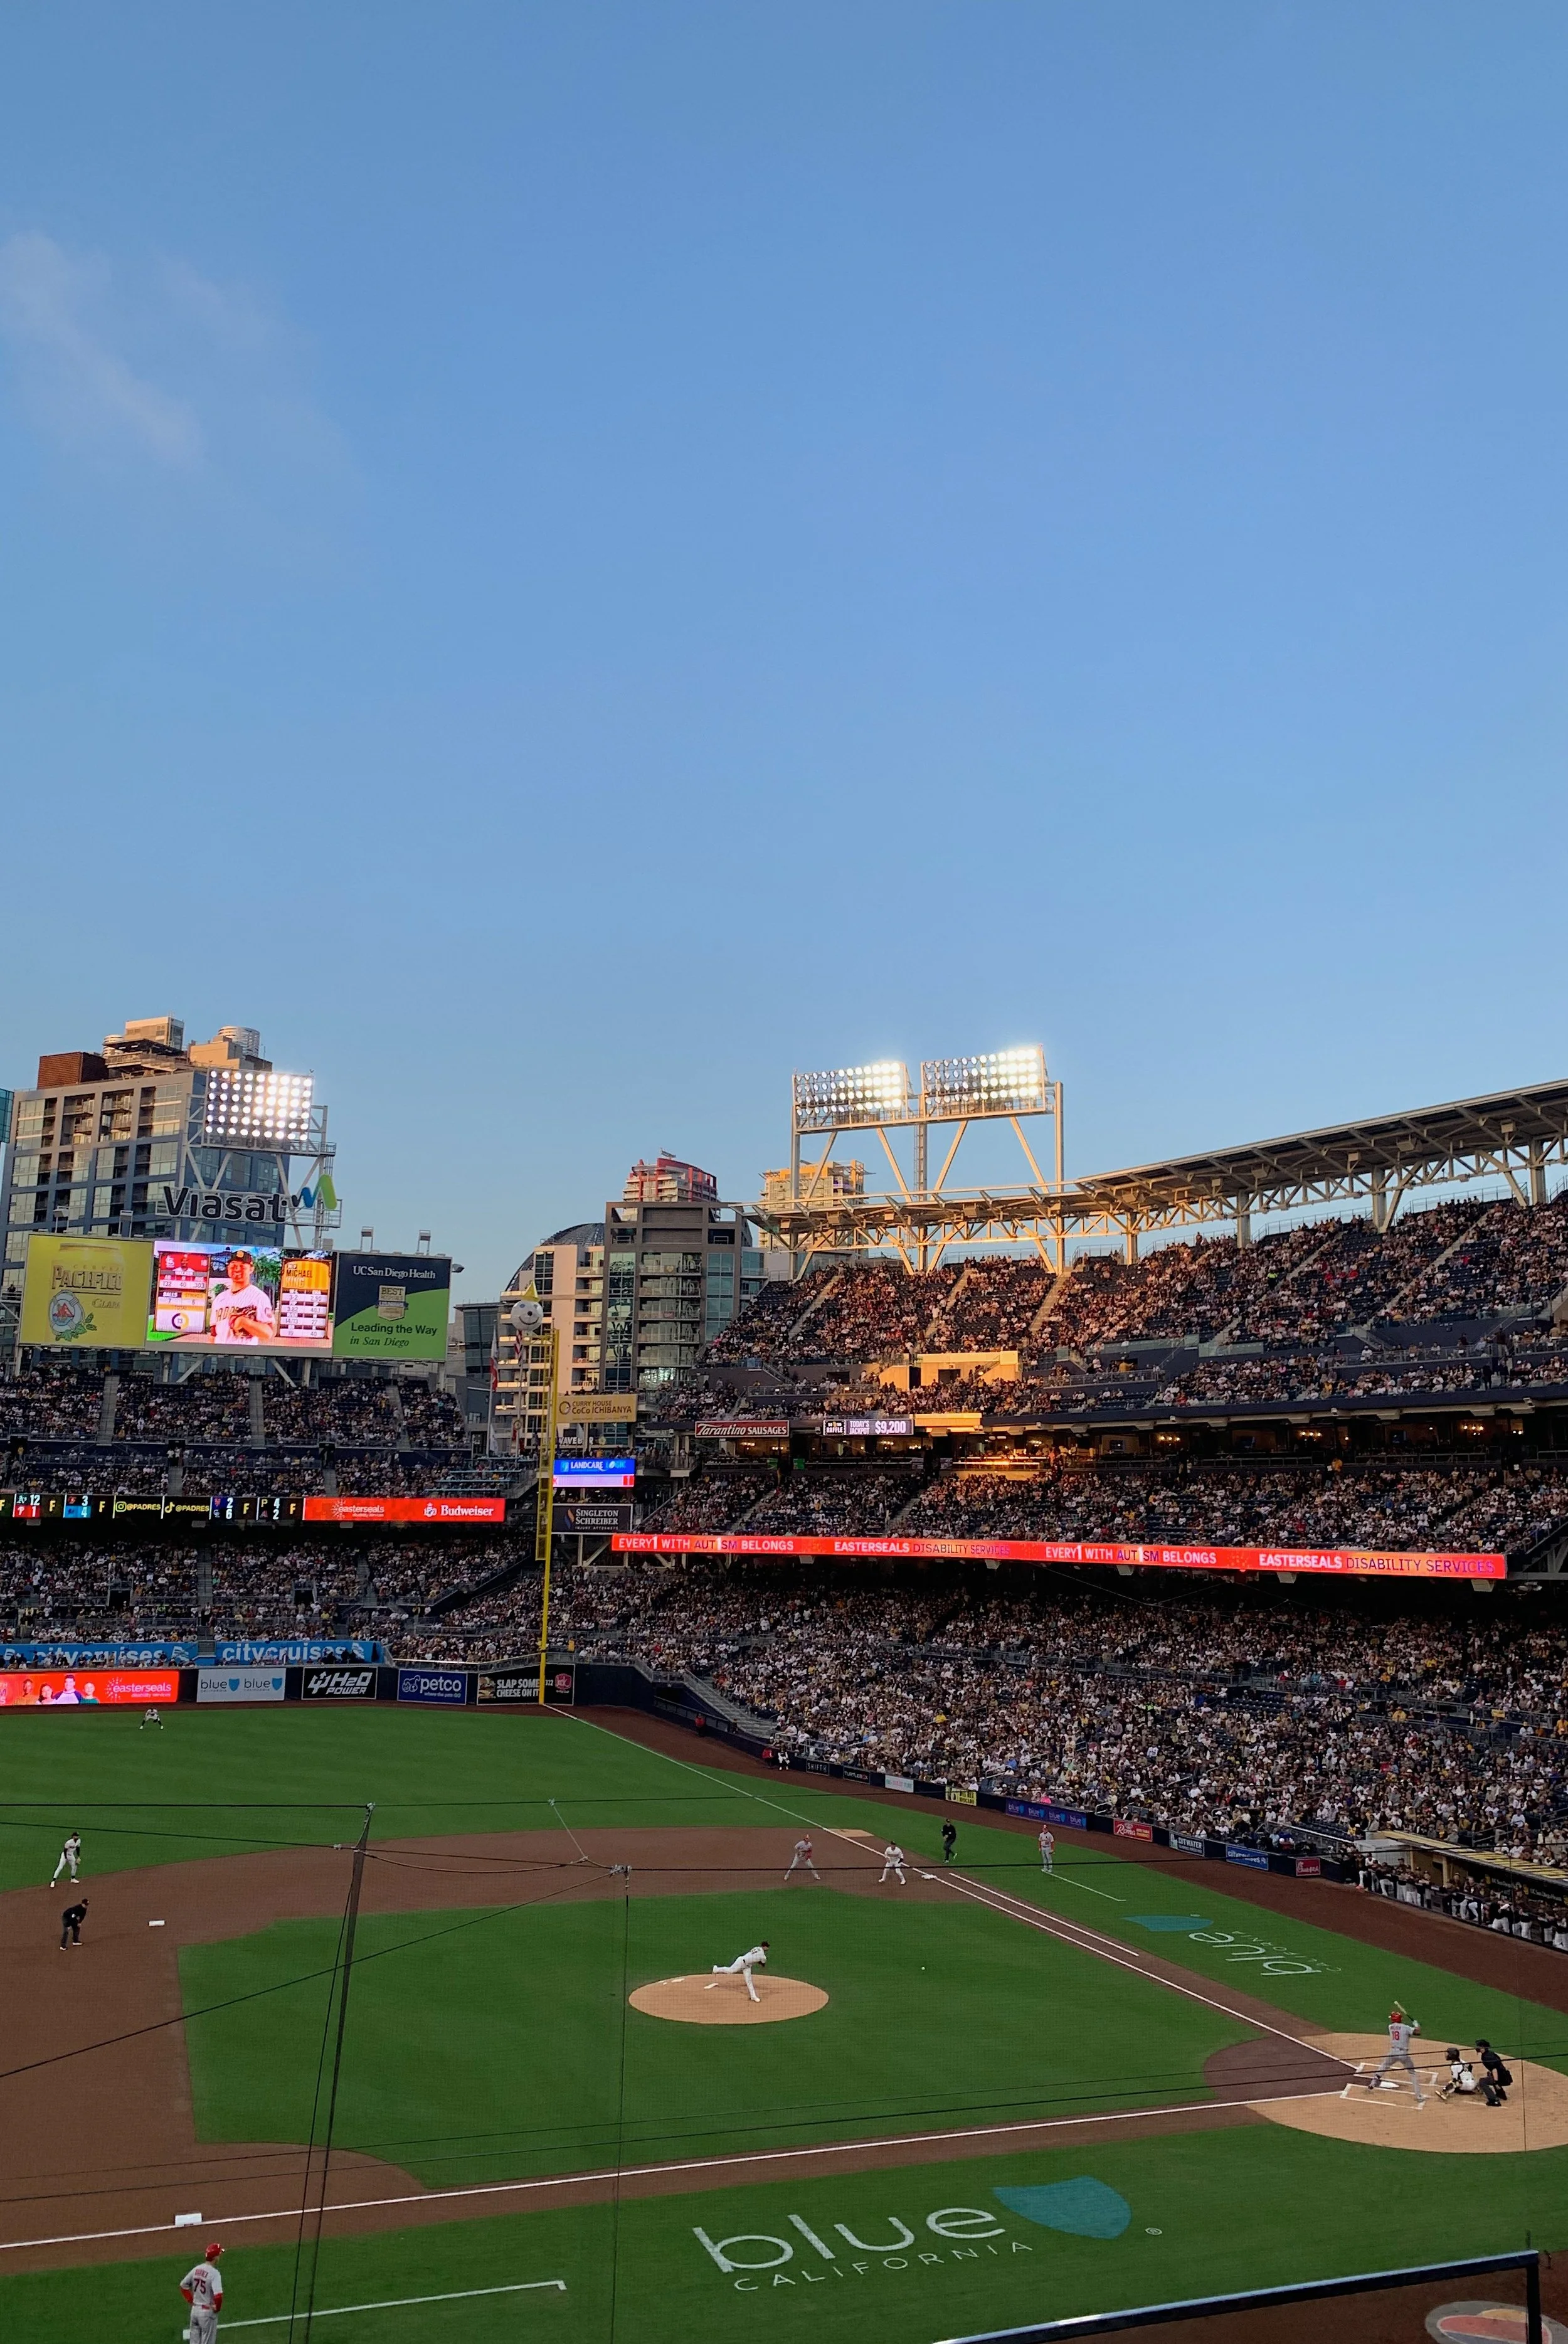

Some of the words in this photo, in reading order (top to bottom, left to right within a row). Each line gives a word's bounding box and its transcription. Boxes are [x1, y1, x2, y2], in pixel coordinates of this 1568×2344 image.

[164, 1186, 285, 1222] Viasat
[287, 1270, 312, 1278] MICHAEL
[352, 1266, 368, 1275] UC
[368, 1266, 384, 1276] San
[384, 1268, 408, 1279] Diego
[409, 1269, 436, 1279] Health
[285, 1277, 305, 1288] KING
[381, 1287, 403, 1295] BEST
[351, 1322, 393, 1335] Leading
[396, 1325, 413, 1334] the
[416, 1325, 438, 1336] Way
[350, 1336, 359, 1345] in
[363, 1337, 380, 1345] San
[384, 1338, 410, 1348] Diego
[697, 1423, 746, 1435] Tarantino
[747, 1426, 787, 1435] SAUSAGES
[875, 1421, 906, 1434] $9,200
[30, 1495, 40, 1505] 12
[82, 1495, 88, 1506] 3
[227, 1497, 233, 1508] 2
[273, 1497, 280, 1508] 4
[49, 1500, 56, 1512] F
[99, 1501, 105, 1512] F
[243, 1503, 250, 1514] F
[290, 1503, 296, 1514] F
[339, 1505, 384, 1513] easterseals
[440, 1505, 494, 1516] Budweiser
[32, 1507, 36, 1517] 1
[81, 1507, 87, 1517] 4
[226, 1509, 232, 1519] 6
[272, 1509, 279, 1520] 2
[576, 1509, 618, 1517] SINGLETON
[575, 1517, 618, 1525] SCHREIBER
[662, 1539, 689, 1549] WITH
[741, 1541, 793, 1551] BELONGS
[834, 1542, 909, 1553] EASTERSEALS
[913, 1543, 968, 1554] DISABILITY
[971, 1544, 1010, 1556] SERVICES
[1085, 1549, 1113, 1560] WITH
[1163, 1551, 1216, 1564] BELONGS
[1259, 1554, 1342, 1569] EASTERSEALS
[1347, 1557, 1421, 1571] DISABILITY
[1426, 1560, 1494, 1573] SERVICES
[201, 1679, 227, 1689] blue
[244, 1678, 270, 1688] blue
[330, 1672, 373, 1686] H2O
[497, 1679, 517, 1689] SLAP
[517, 1678, 540, 1689] SOME
[113, 1682, 171, 1692] easterseals
[420, 1676, 462, 1694] petco
[496, 1689, 521, 1697] CHEESE
[521, 1689, 532, 1697] ON
[1009, 1803, 1019, 1811] blue
[1029, 1807, 1039, 1815] blue
[1070, 1815, 1081, 1823] blue
[1116, 1824, 1135, 1836] Roma
[1189, 1932, 1322, 1976] blue
[1392, 2030, 1399, 2040] 18
[692, 2207, 1005, 2272] blue
[734, 2241, 1032, 2291] CALIFORNIA
[194, 2278, 206, 2294] 75
